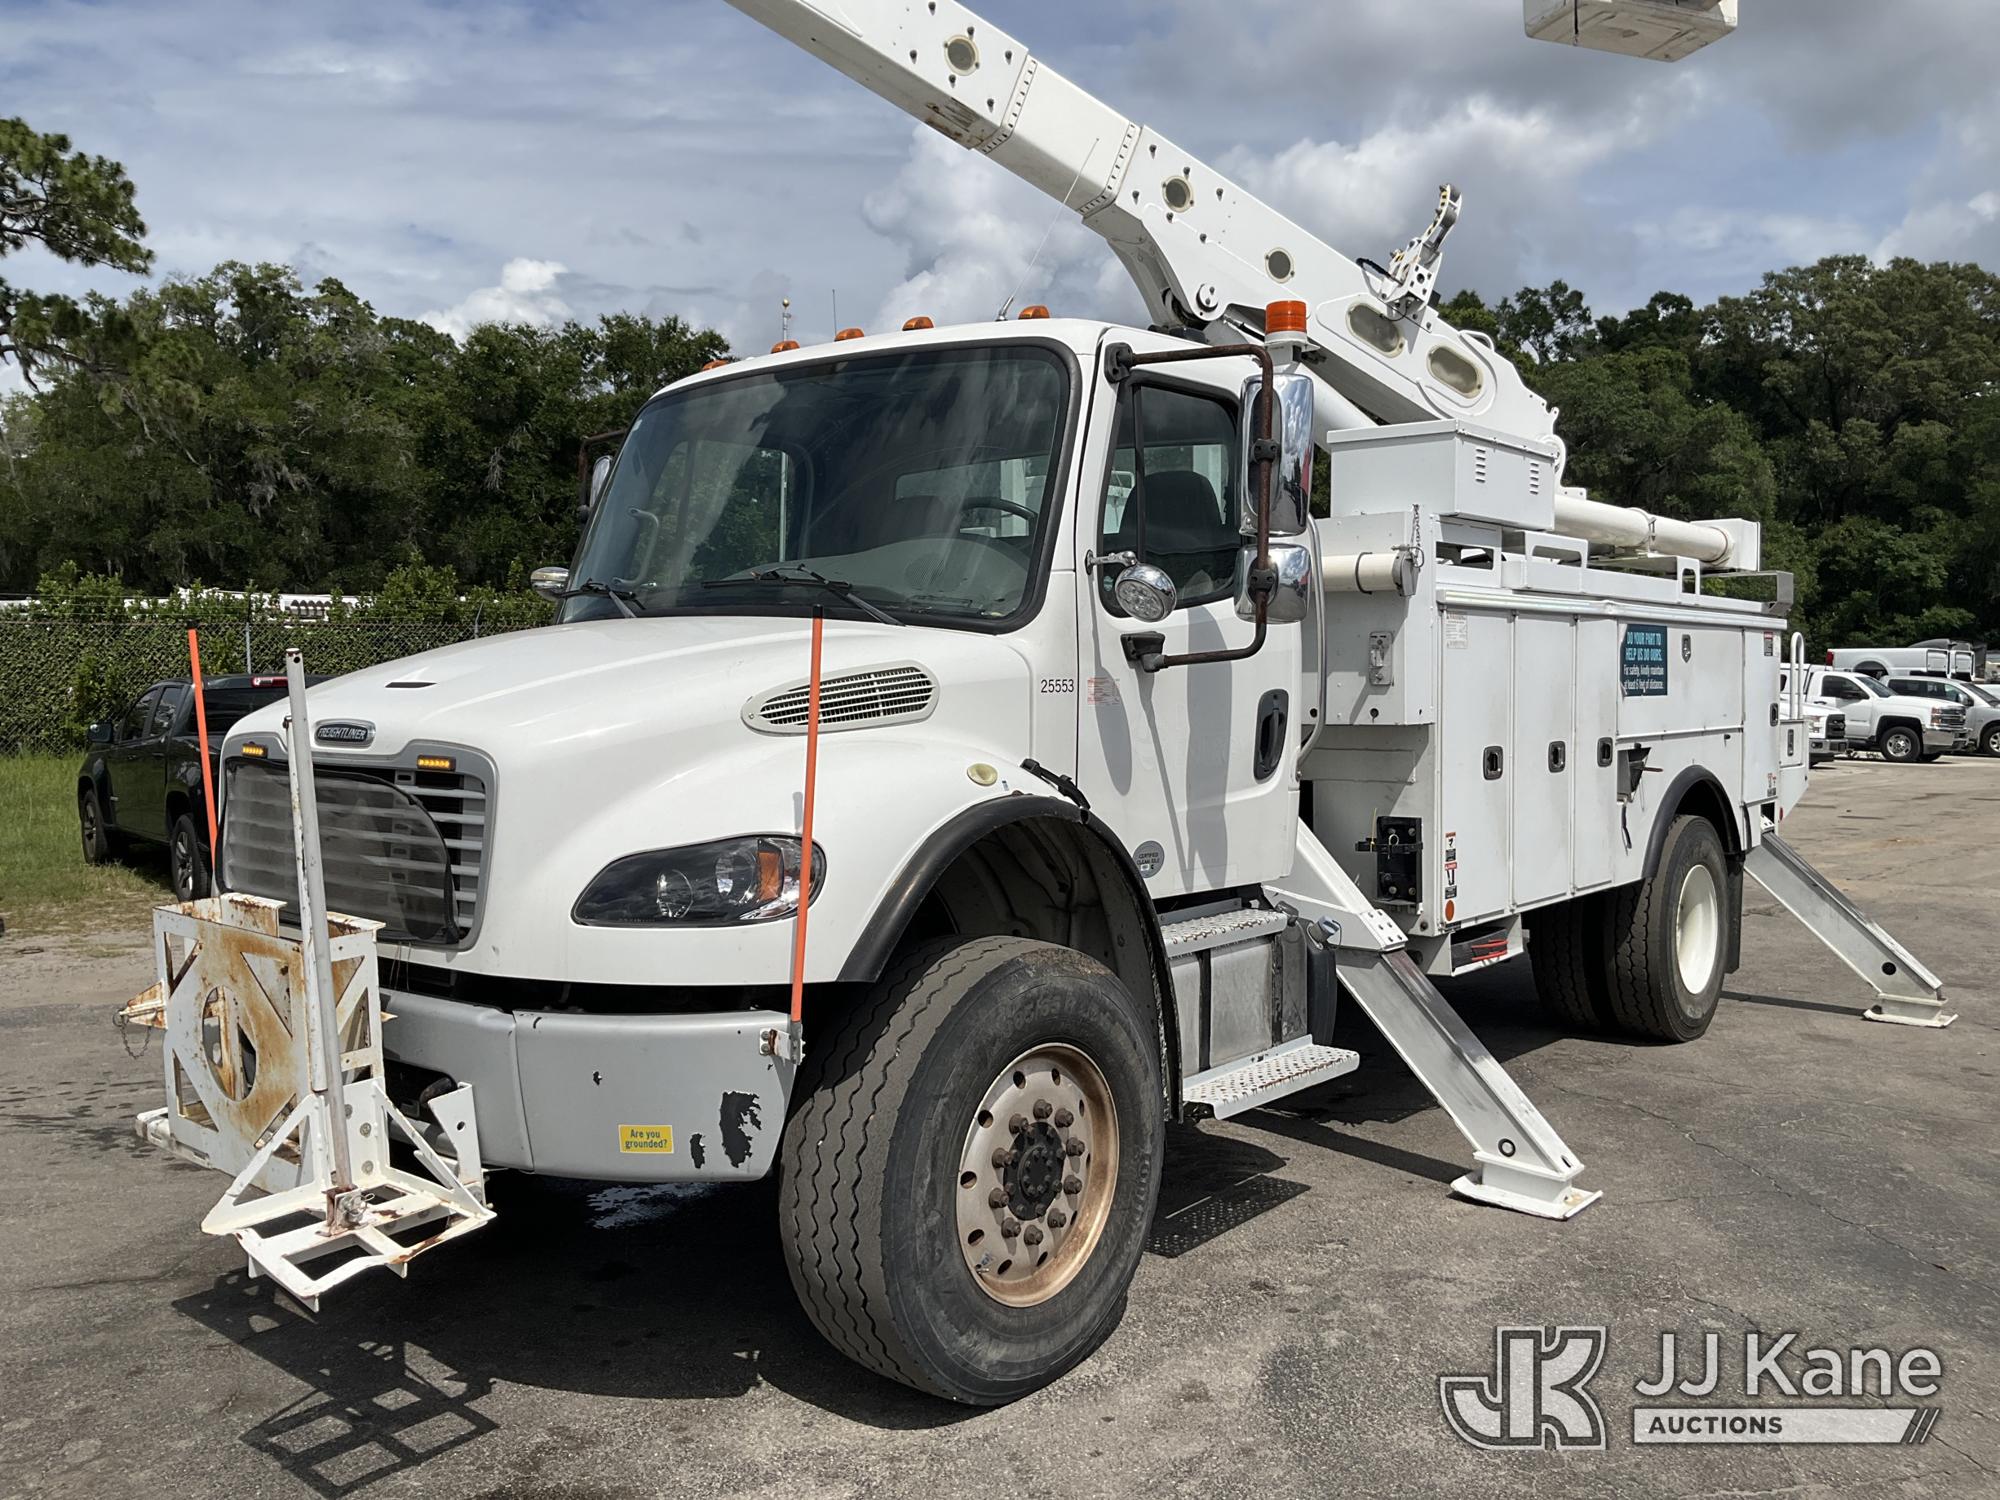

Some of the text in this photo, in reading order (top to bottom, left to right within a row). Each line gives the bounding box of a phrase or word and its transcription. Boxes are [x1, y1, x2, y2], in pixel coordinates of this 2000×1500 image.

[1627, 631, 1634, 644] DO
[1625, 647, 1637, 661] HELP
[1040, 678, 1075, 693] 25553
[317, 727, 367, 740] FREIGHTLINER
[630, 1129, 661, 1140] Are you
[625, 1139, 668, 1150] grounded?
